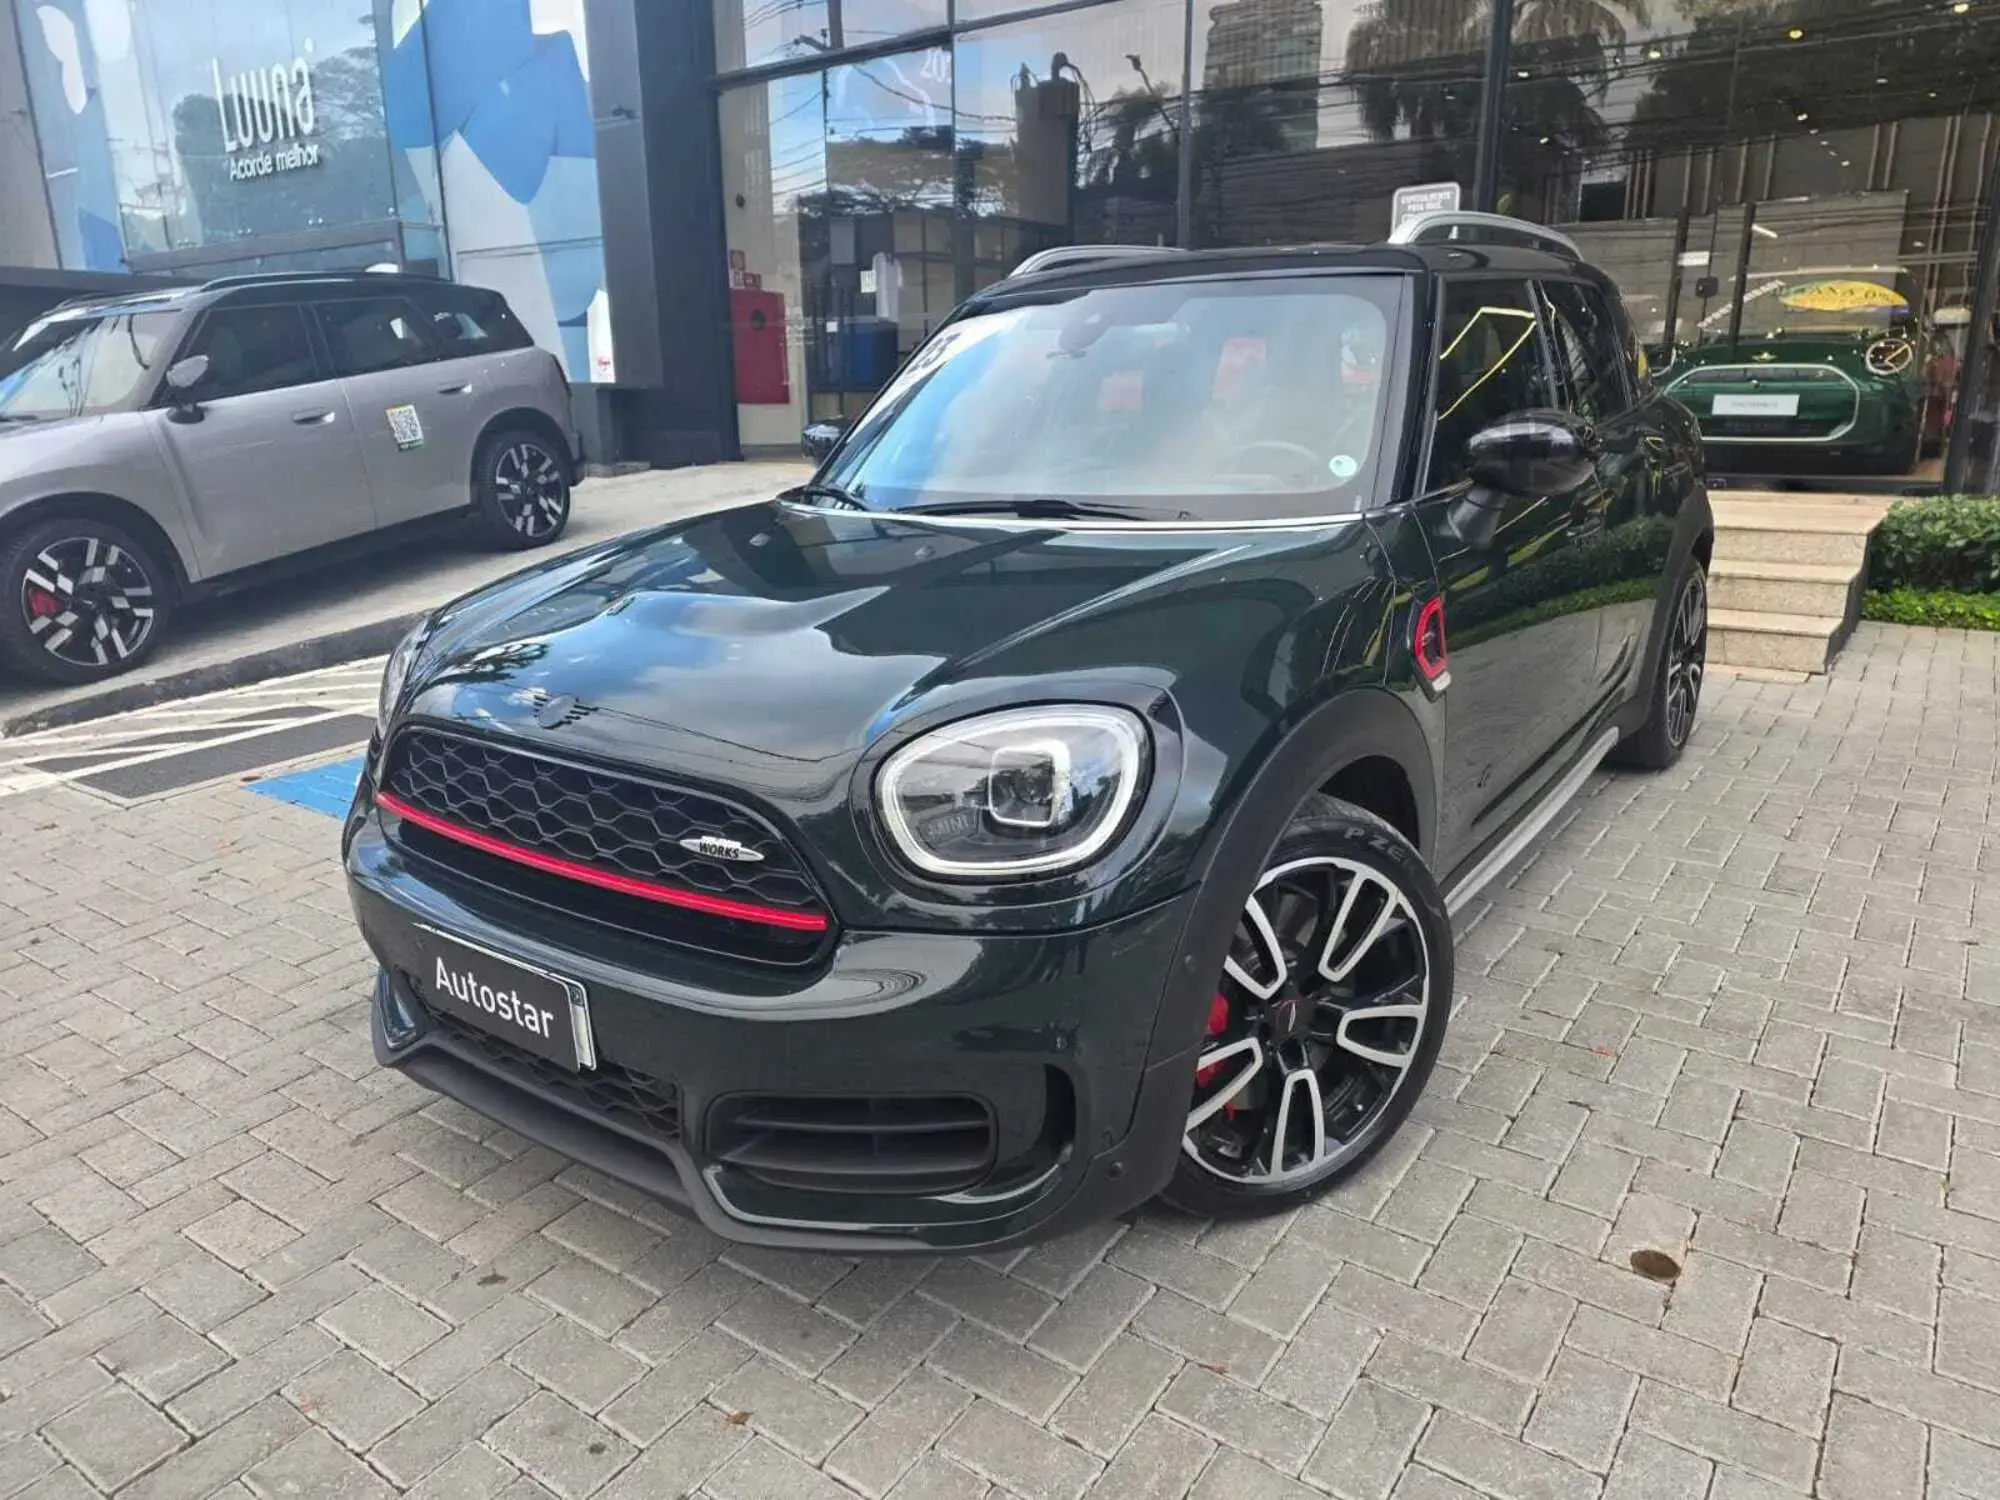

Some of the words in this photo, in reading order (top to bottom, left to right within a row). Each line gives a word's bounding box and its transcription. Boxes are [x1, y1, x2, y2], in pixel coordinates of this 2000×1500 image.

[229, 151, 273, 181] Acorde
[275, 142, 320, 172] melhor
[699, 841, 740, 859] WORKS
[434, 957, 554, 1039] Autostar
